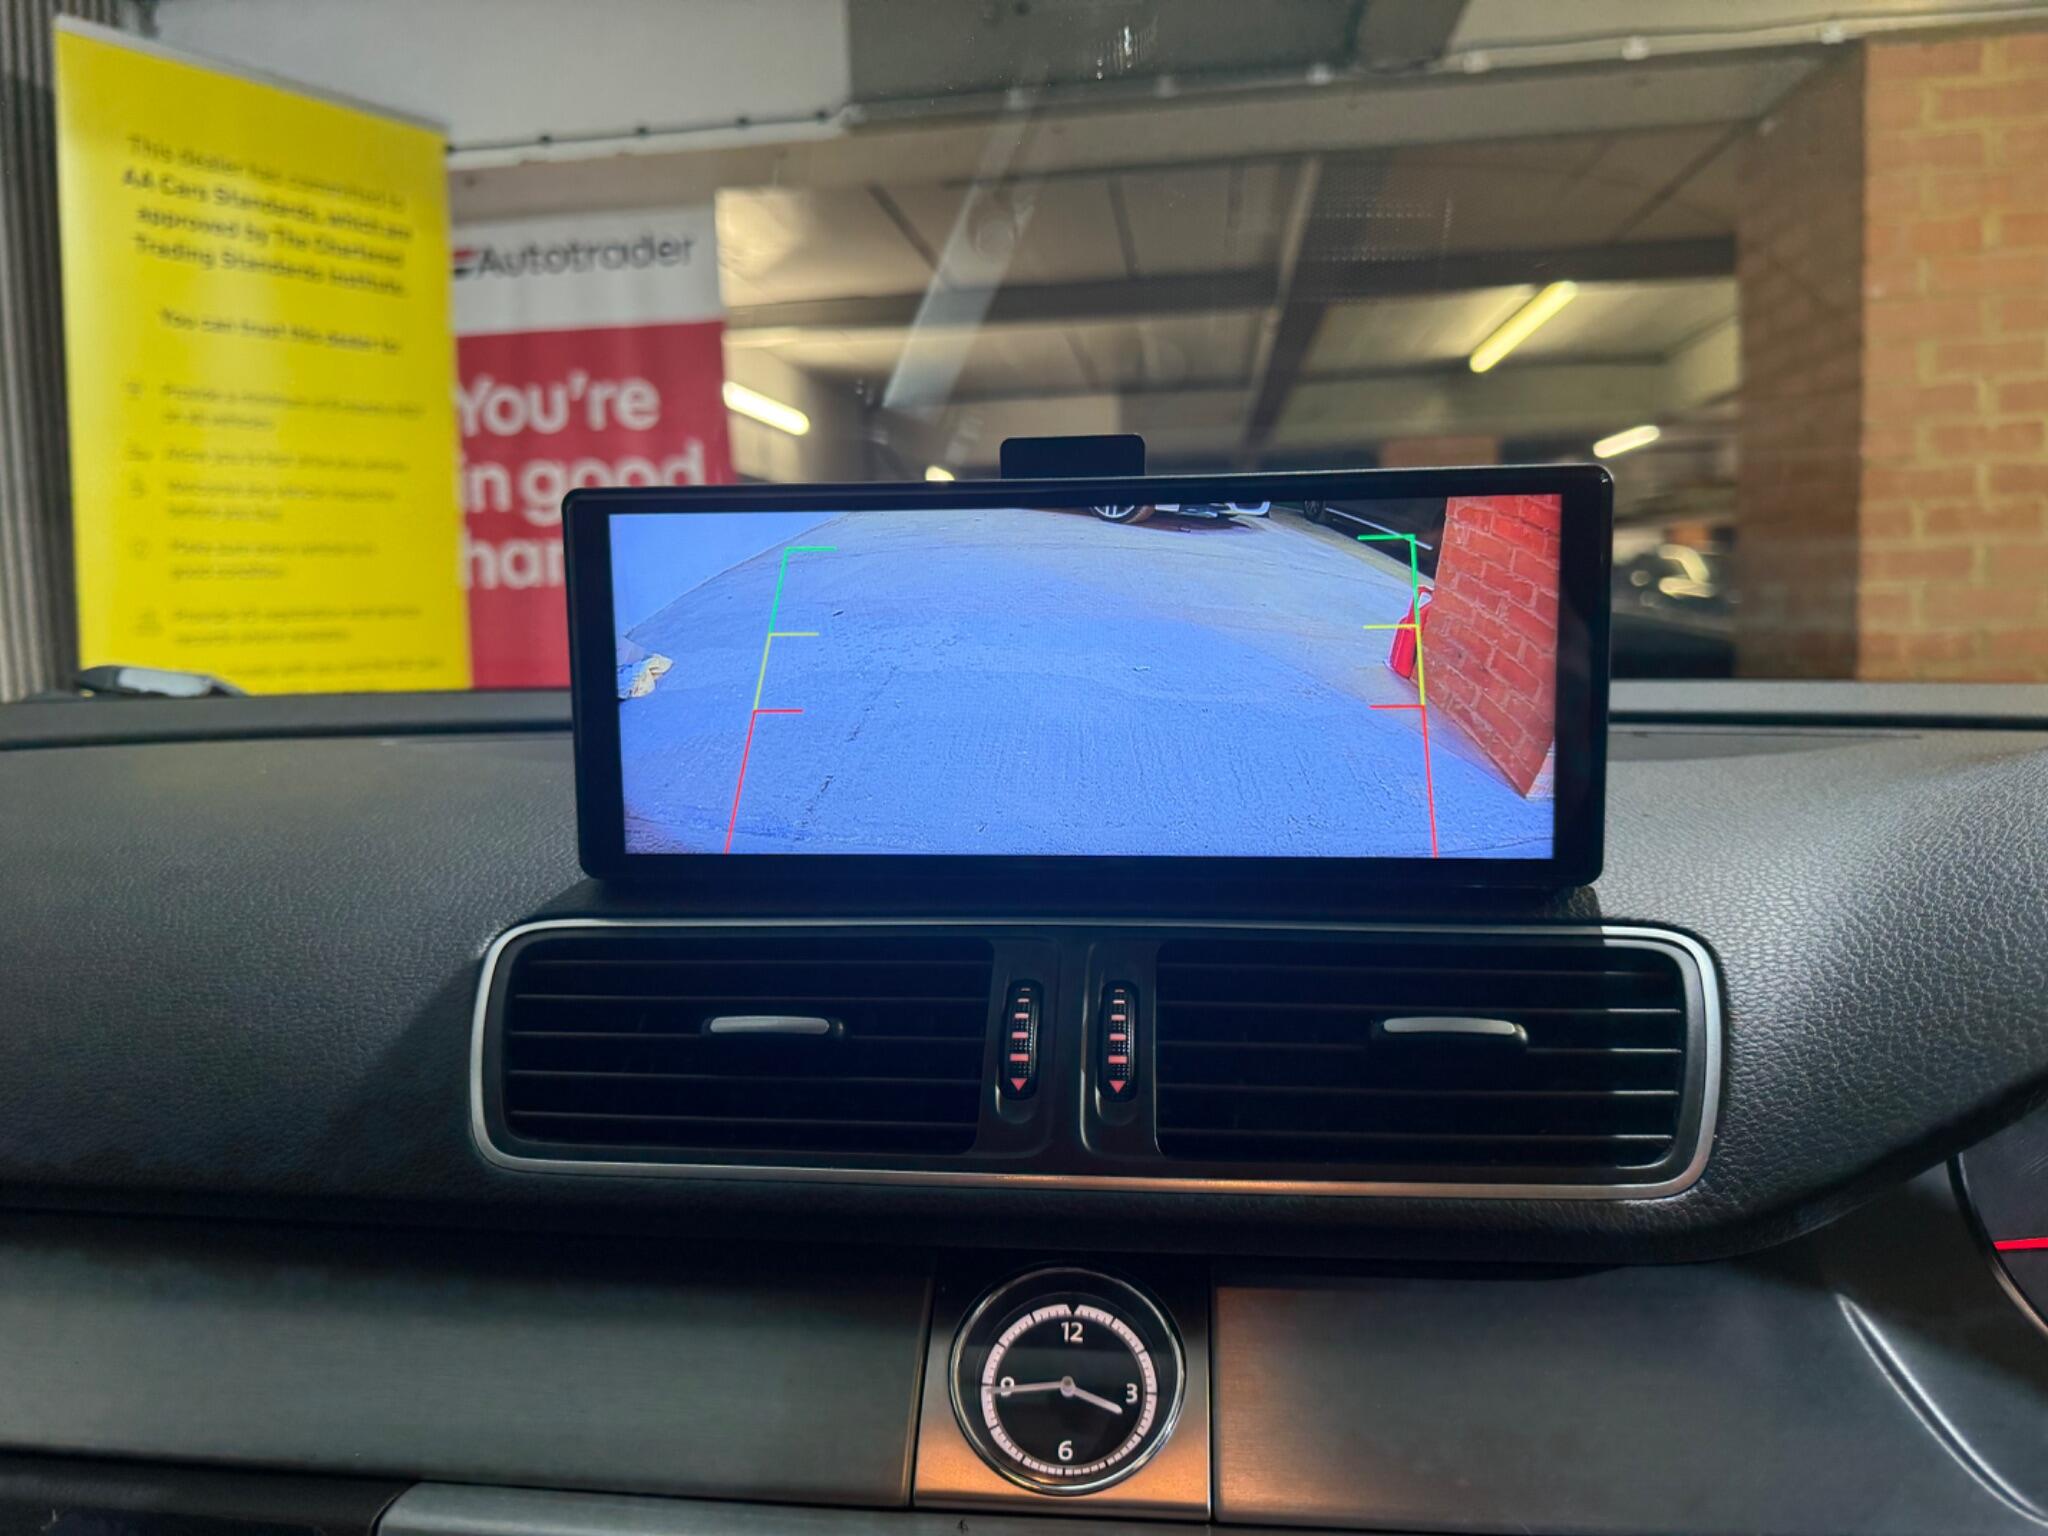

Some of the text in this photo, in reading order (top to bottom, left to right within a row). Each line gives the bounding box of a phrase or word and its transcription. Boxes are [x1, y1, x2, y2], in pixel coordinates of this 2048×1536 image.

[478, 234, 695, 279] Autotrader
[1060, 1321, 1084, 1343] 12
[1125, 1383, 1138, 1404] 3
[1057, 1440, 1073, 1461] 6
